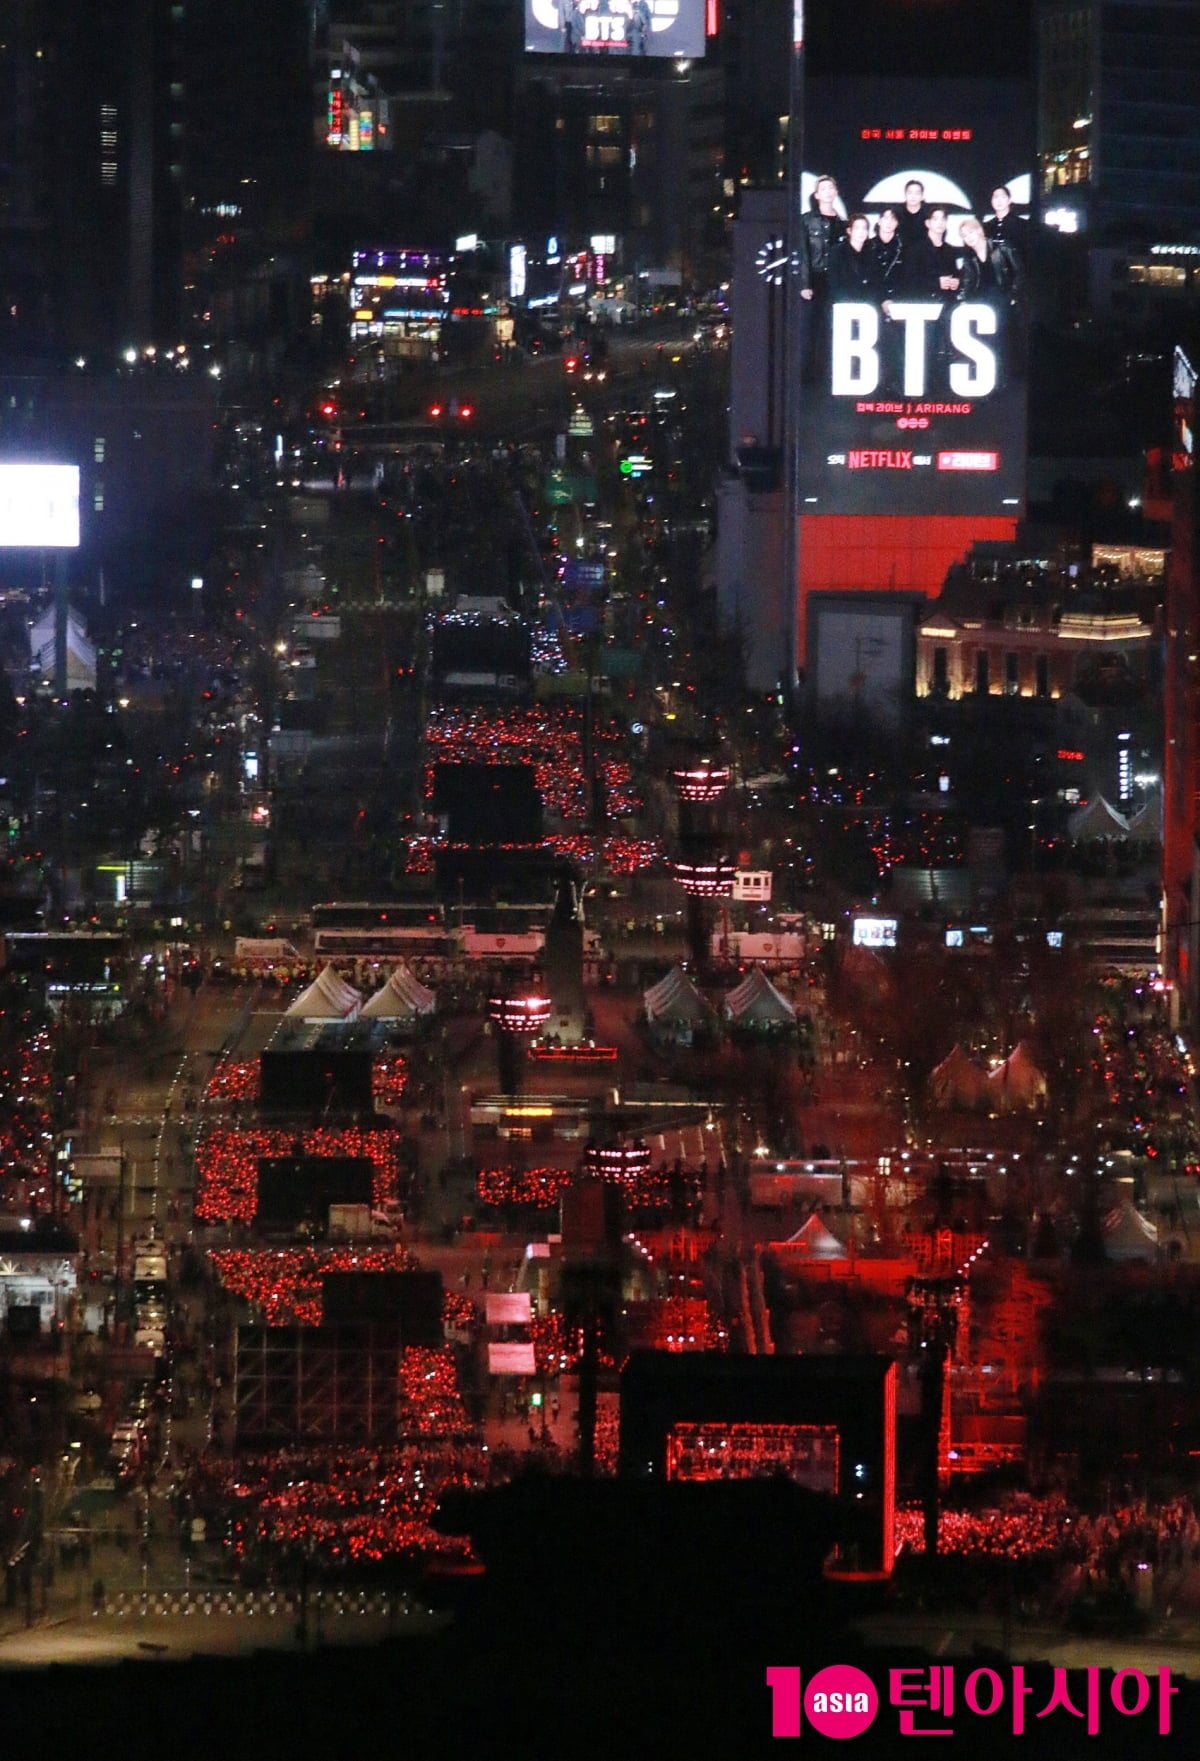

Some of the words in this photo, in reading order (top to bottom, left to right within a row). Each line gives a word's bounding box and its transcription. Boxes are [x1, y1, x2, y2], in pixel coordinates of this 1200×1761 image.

[909, 129, 938, 140] 라이브
[832, 303, 997, 397] BTS
[915, 404, 971, 414] ARIRANG
[848, 450, 912, 469] NETFLIX
